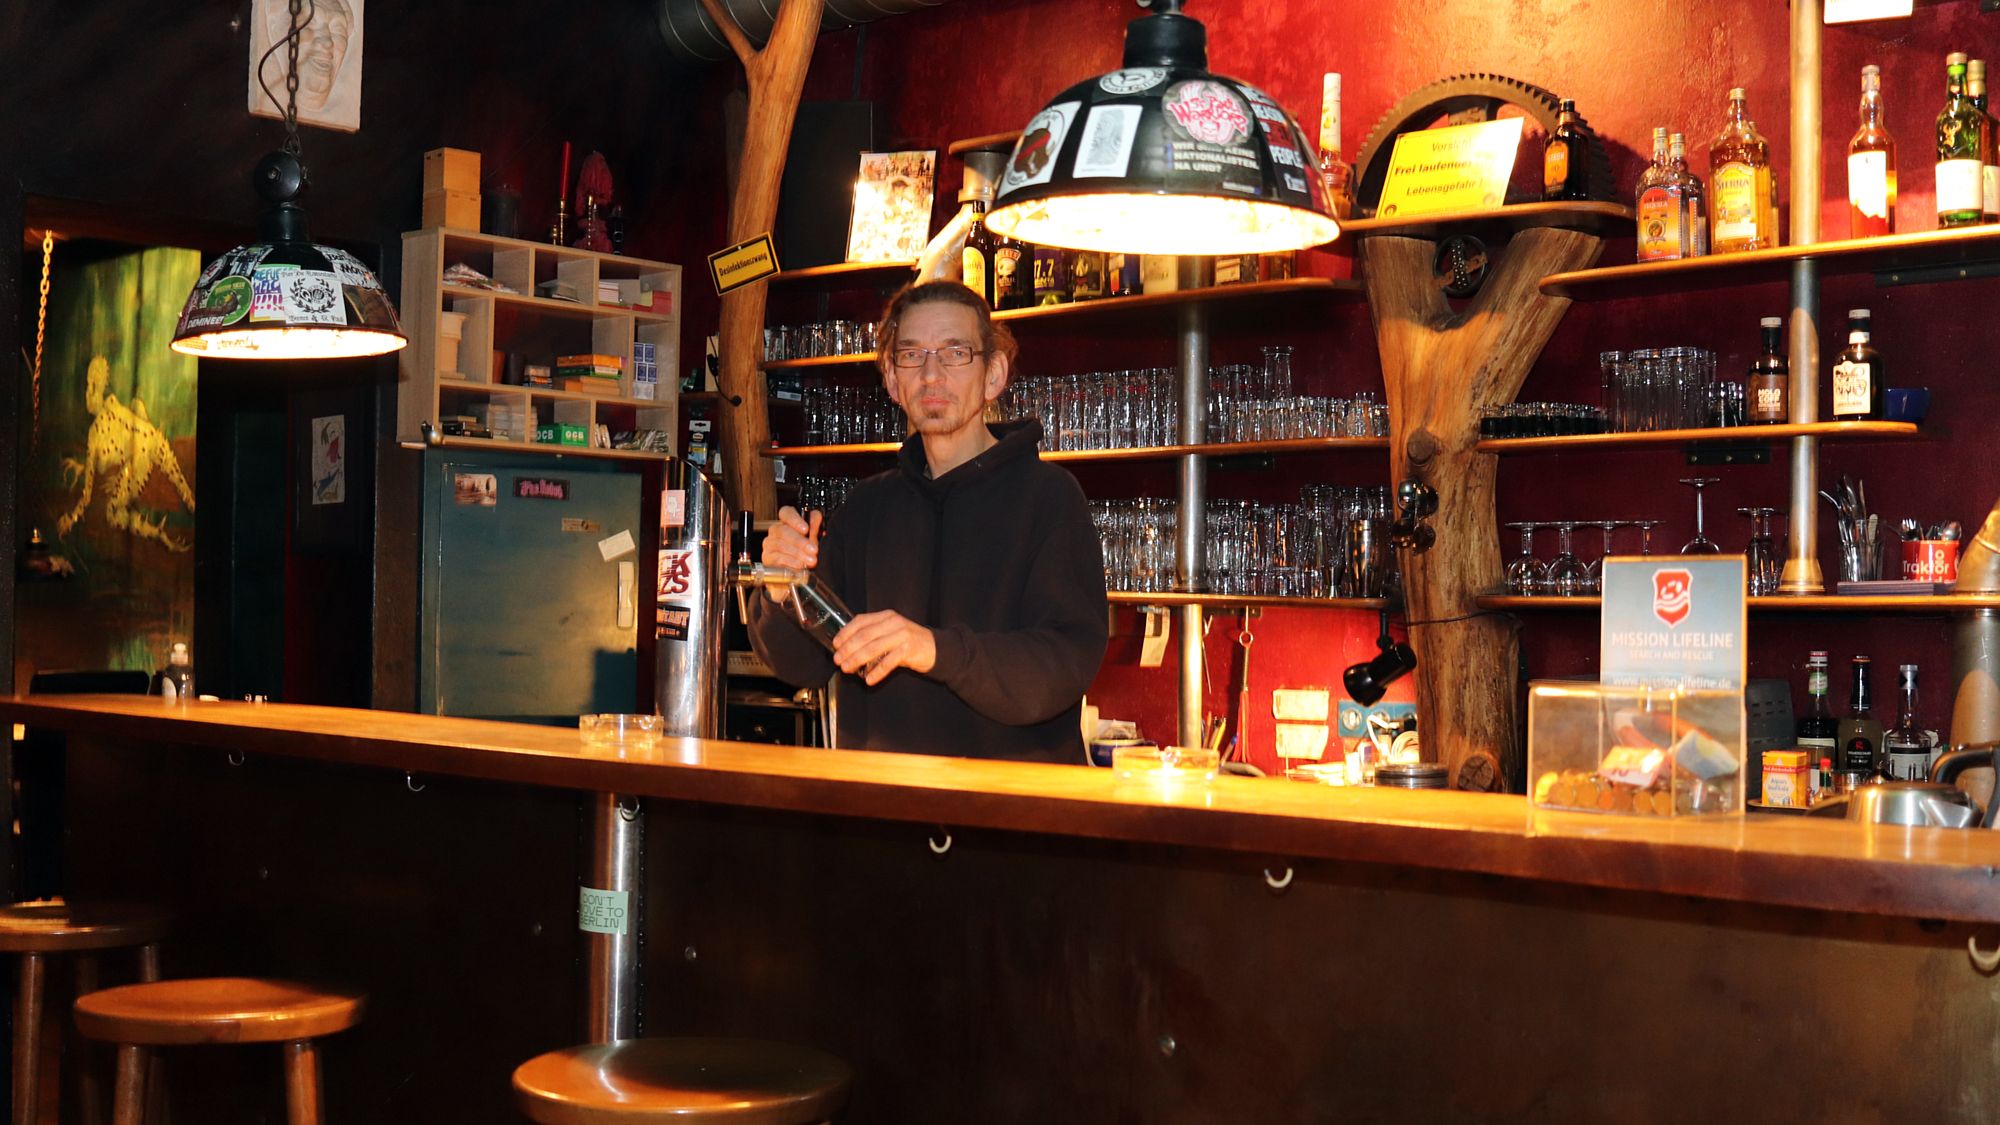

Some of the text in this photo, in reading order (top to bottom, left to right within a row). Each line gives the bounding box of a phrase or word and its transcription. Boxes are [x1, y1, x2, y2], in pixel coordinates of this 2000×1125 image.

[565, 431, 584, 440] OCB
[1612, 632, 1734, 648] MISSION LIFELINE
[606, 907, 625, 918] TO
